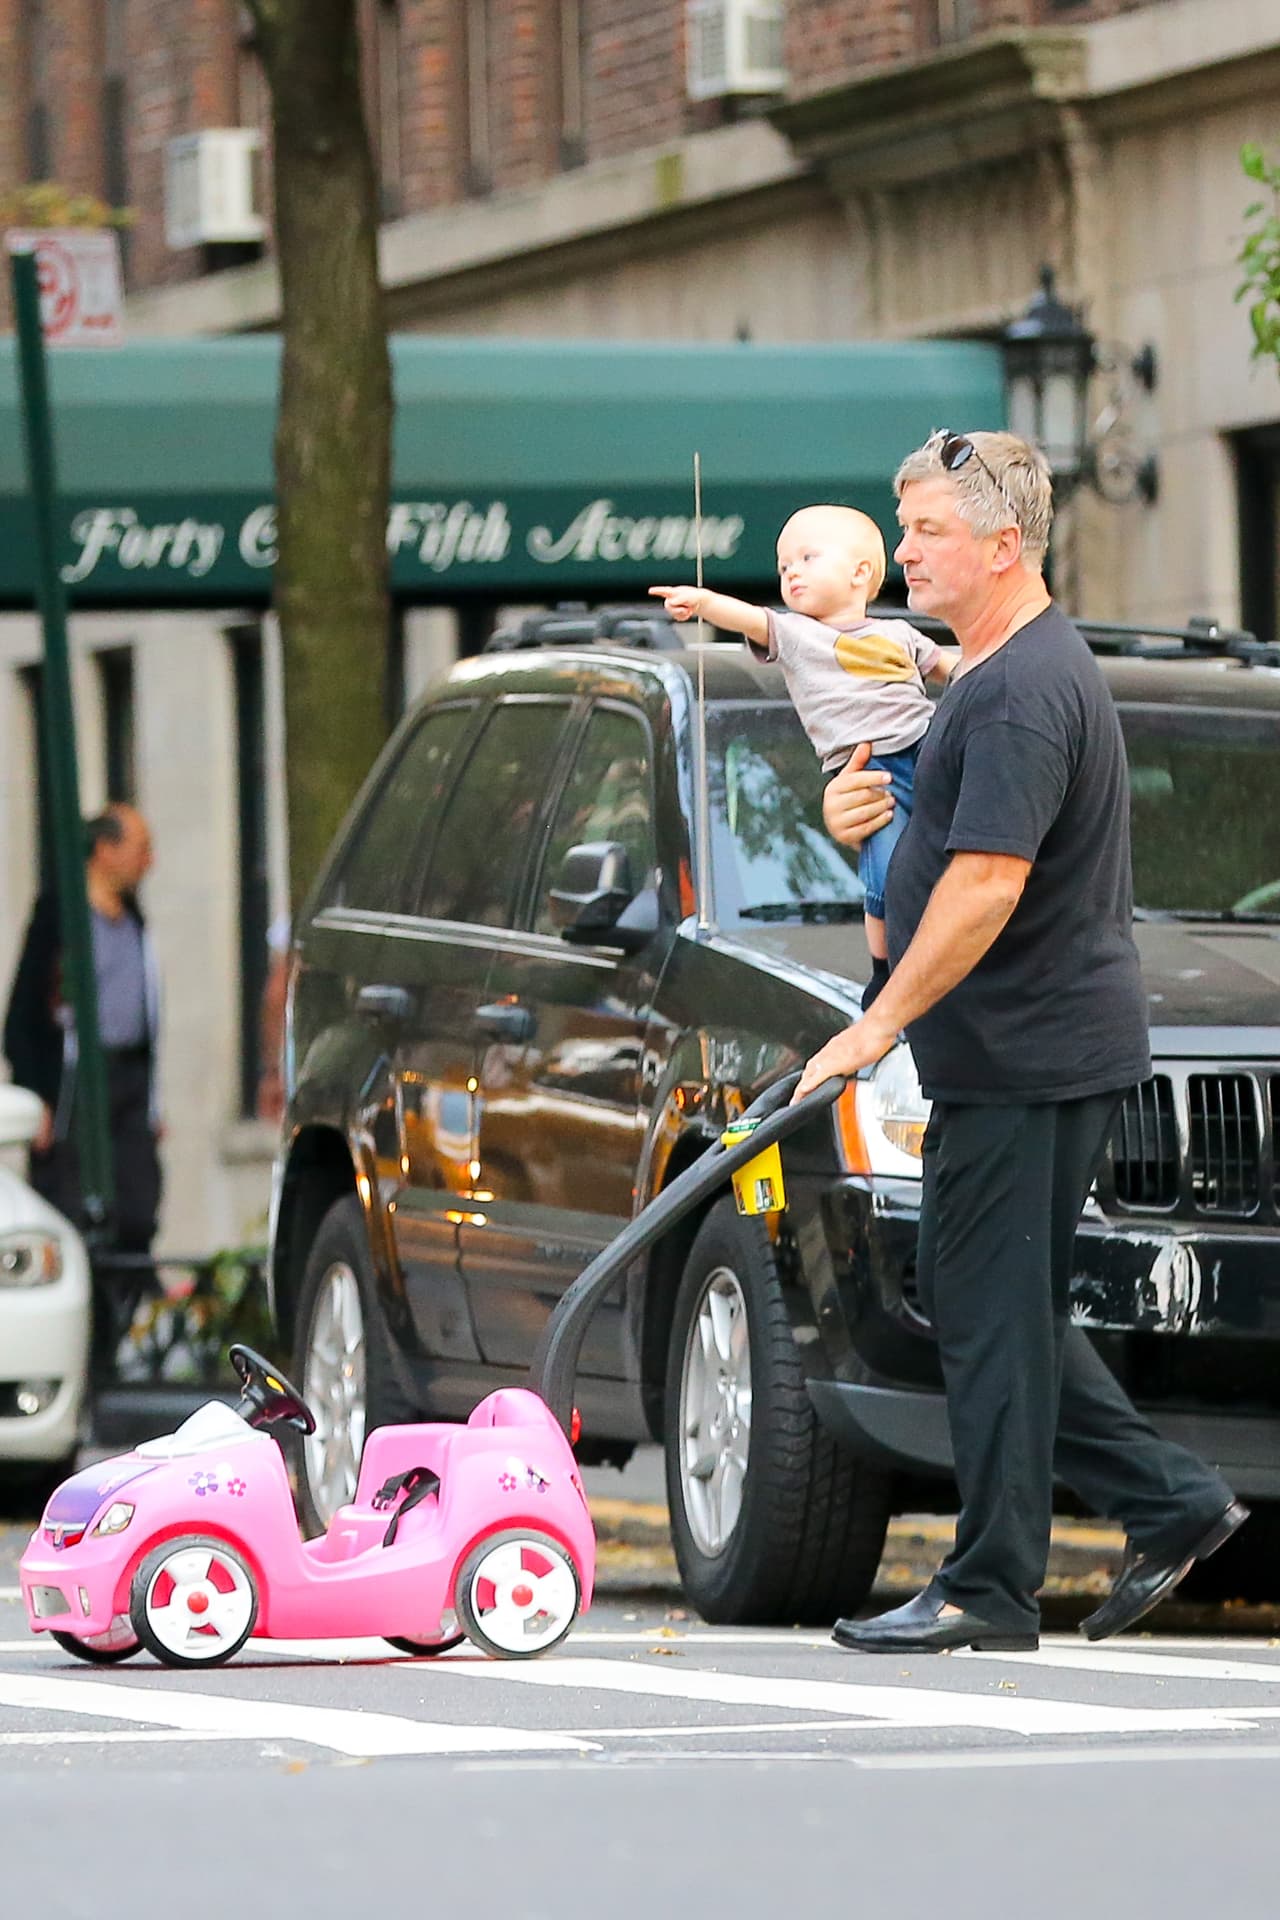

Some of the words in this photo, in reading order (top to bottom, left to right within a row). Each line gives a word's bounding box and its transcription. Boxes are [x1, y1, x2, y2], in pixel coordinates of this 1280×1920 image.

[60, 507, 225, 584] Forty
[386, 501, 512, 573] Fifth
[527, 499, 745, 564] Avenue
